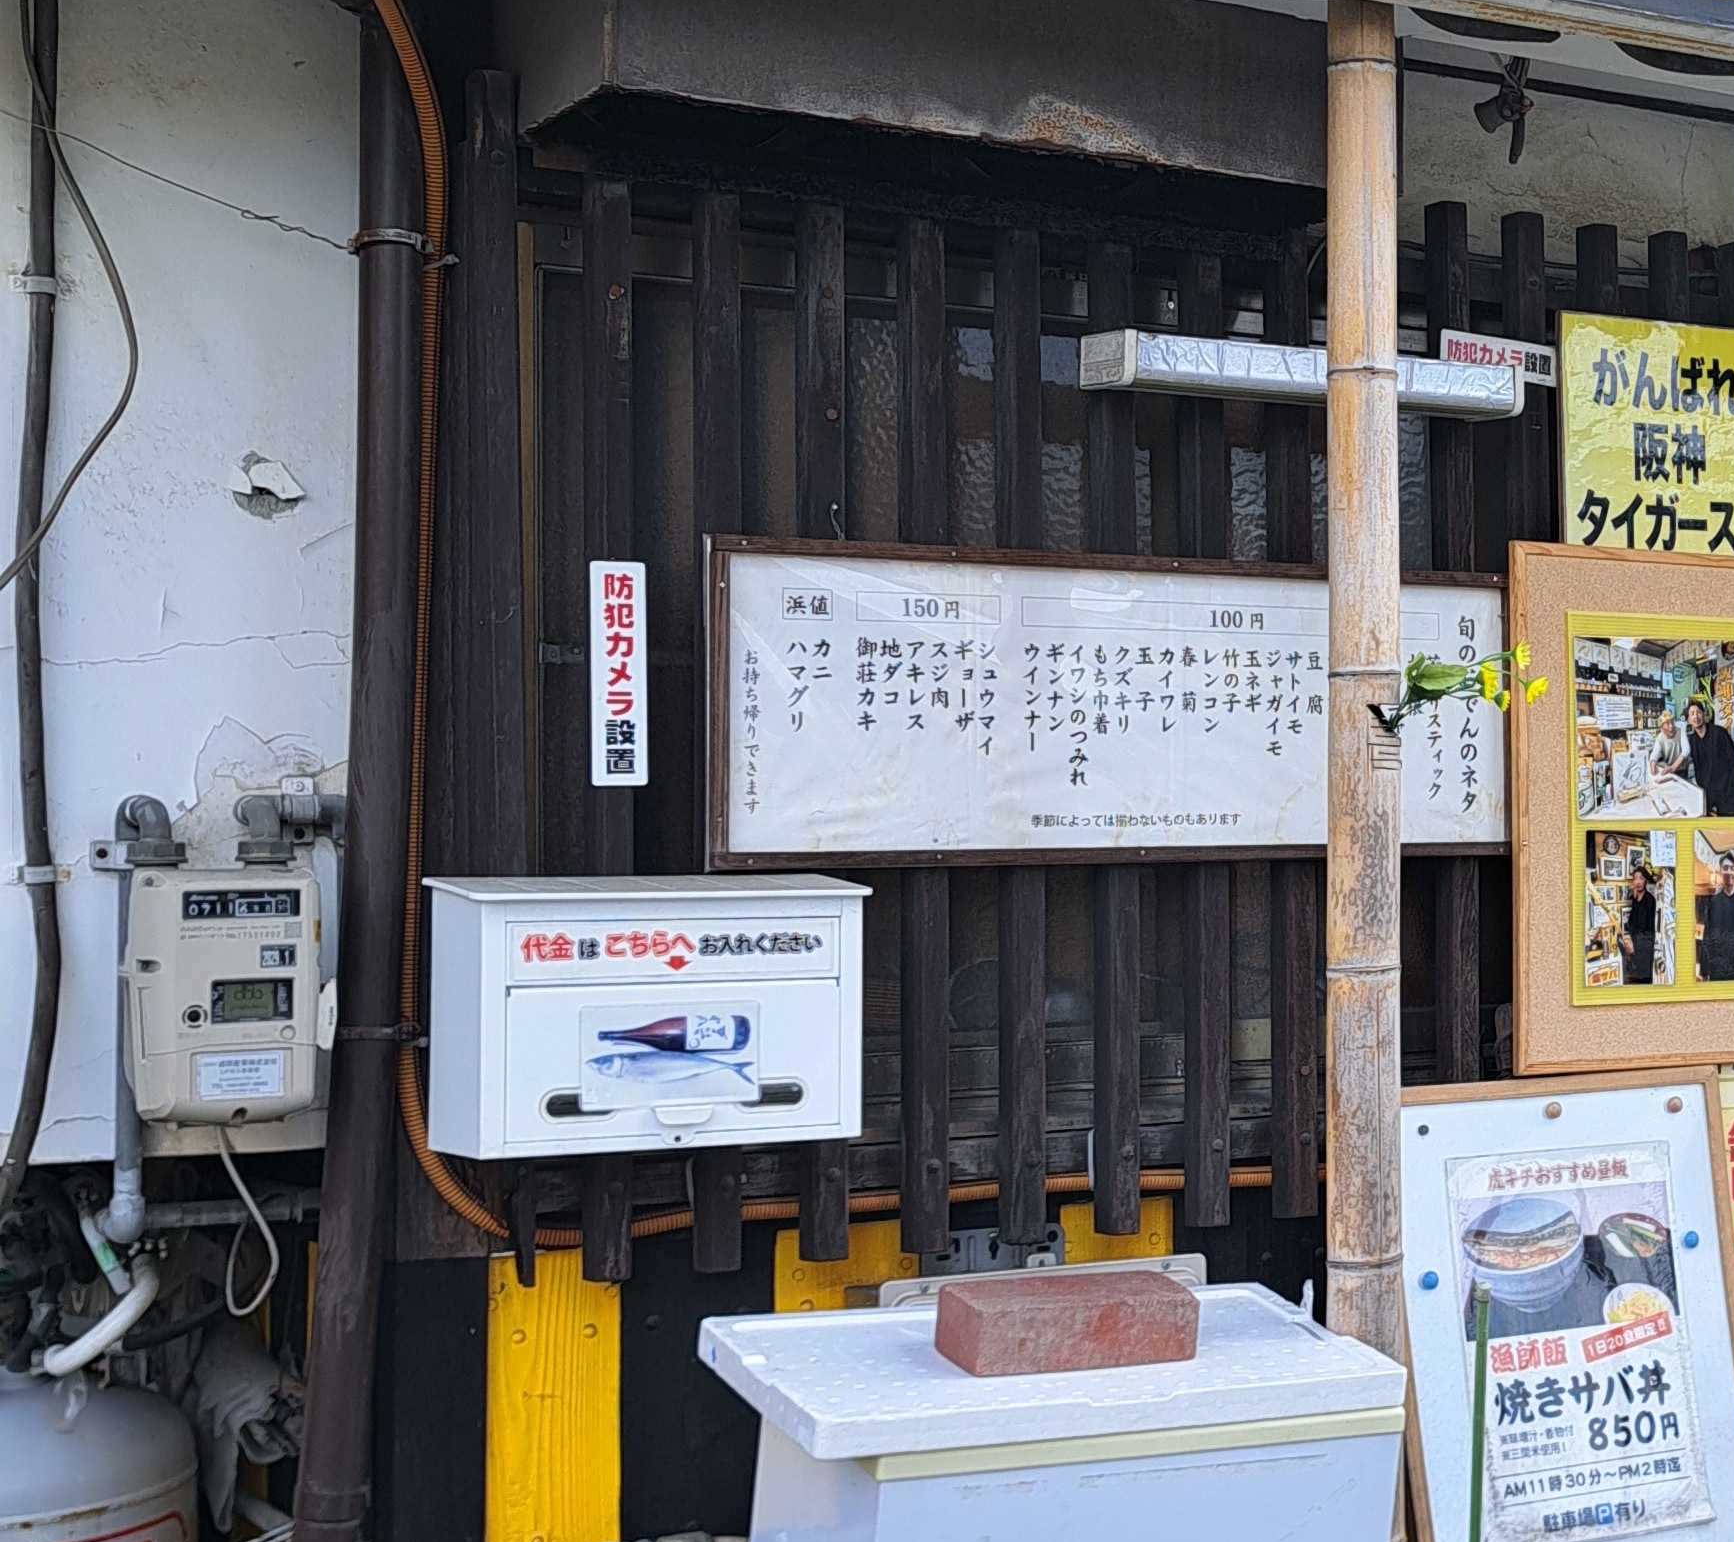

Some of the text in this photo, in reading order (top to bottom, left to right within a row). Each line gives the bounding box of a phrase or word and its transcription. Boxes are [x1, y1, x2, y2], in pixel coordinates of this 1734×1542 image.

[1633, 422, 1707, 485] 阪神
[785, 596, 830, 616] 浜値
[901, 599, 960, 619] 150円
[1208, 609, 1264, 630] 100円
[604, 573, 636, 775] 防犯カメラ設置
[787, 641, 809, 732] ハマグリ
[812, 639, 832, 680] カニ
[856, 637, 877, 731] 御荘カキ
[879, 638, 903, 705] 地ダコ
[906, 640, 925, 731] アキレス
[930, 641, 950, 708] スジ肉
[954, 639, 975, 732] ギョーザ
[977, 641, 998, 756] シュウマイ
[1023, 643, 1041, 751] ウインナー
[1046, 643, 1065, 732] ギンナン
[1092, 644, 1110, 734] もち巾着
[1114, 646, 1133, 734] クズキリ
[1135, 646, 1155, 712] 玉子
[1158, 648, 1177, 734] カイワレ
[1179, 646, 1198, 713] 春菊
[1203, 649, 1220, 733] レンコン
[1222, 649, 1241, 713] 竹の子
[1244, 649, 1262, 712] 玉ネギ
[1285, 650, 1303, 734] サトイモ
[1305, 653, 1324, 715] 豆腐
[742, 651, 761, 815] お持ち帰りできます
[1068, 645, 1088, 786] イワシのつみれ
[1266, 649, 1282, 757] ジャガイモ
[1457, 616, 1480, 813] 旬のでんのネタ
[1031, 812, 1241, 827] 季節によっては揃わないものもあります
[1490, 1336, 1567, 1373] 漁師飯
[1495, 1359, 1671, 1425] 焼きサバ丼
[1588, 1411, 1679, 1451] 850円
